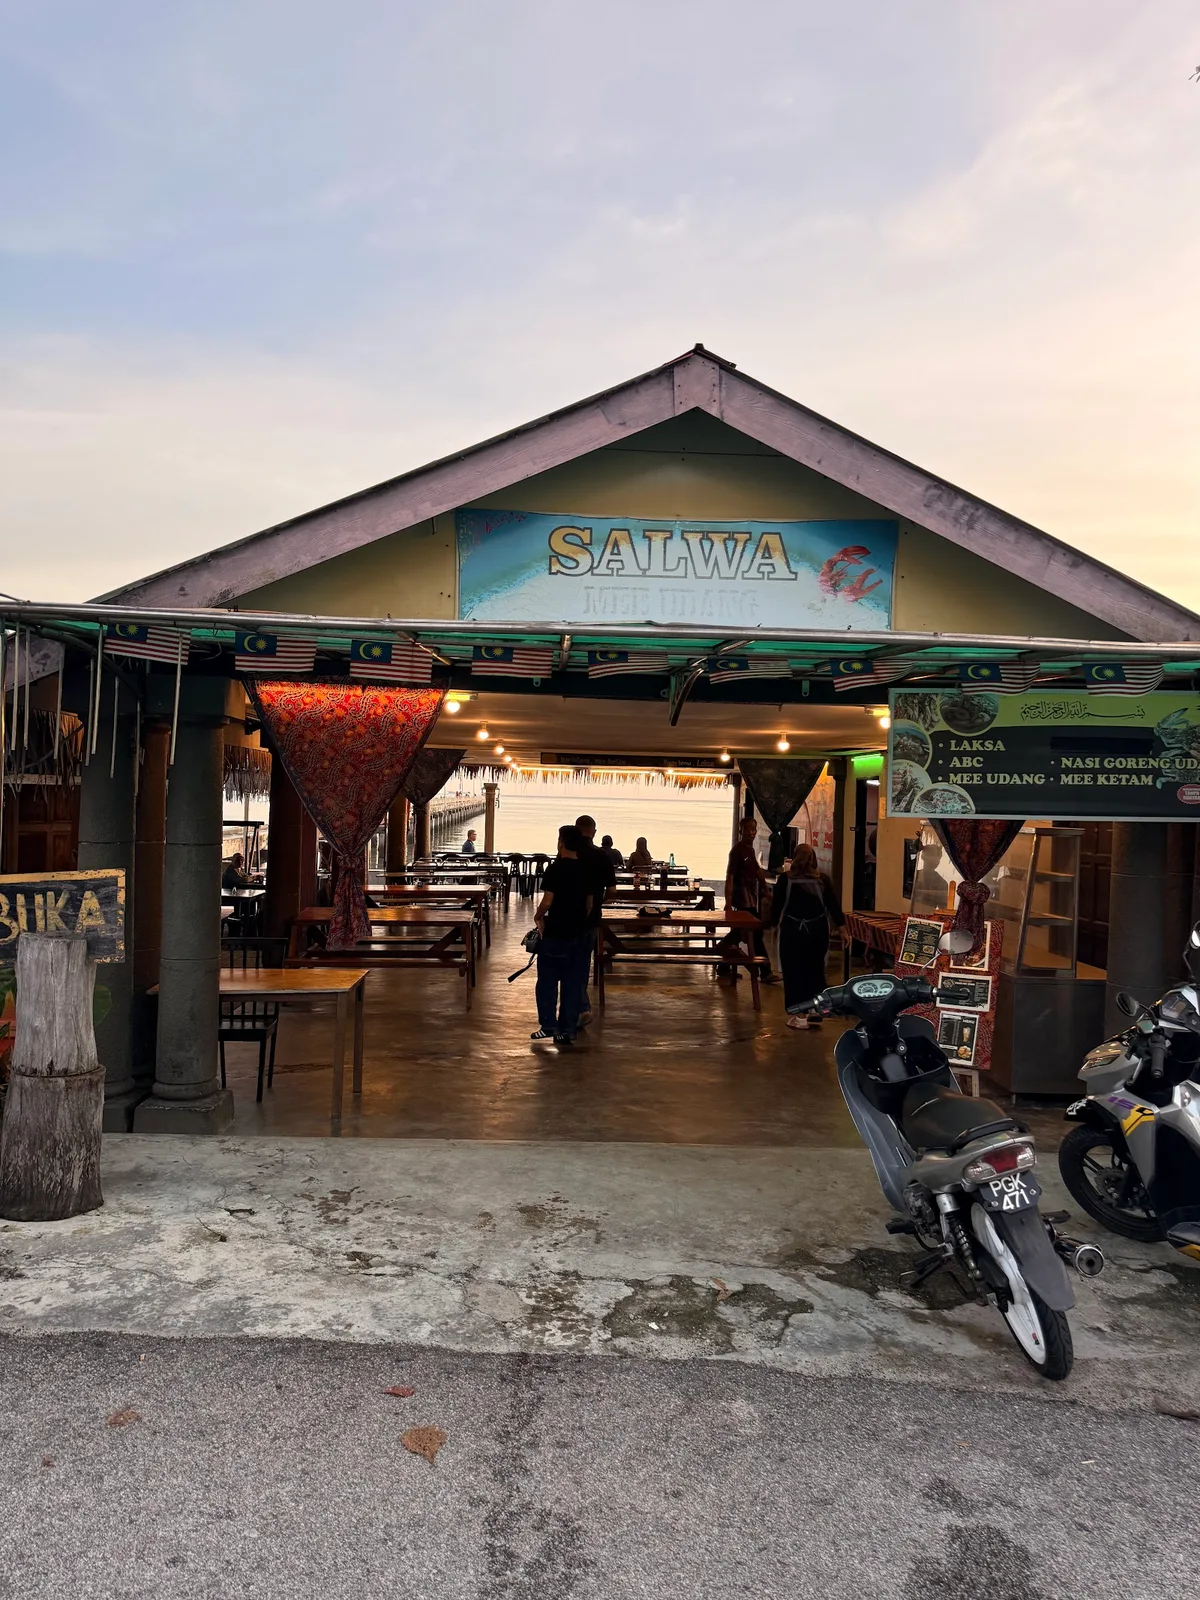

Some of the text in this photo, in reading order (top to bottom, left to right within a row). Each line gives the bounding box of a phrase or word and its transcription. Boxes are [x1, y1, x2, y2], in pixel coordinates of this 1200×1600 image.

[548, 526, 798, 582] SALWA
[949, 740, 1005, 751] LAKSA
[949, 756, 983, 768] ABC
[1060, 757, 1200, 770] NASI GORENG UD
[948, 773, 1045, 785] MEE UDANG
[1060, 773, 1153, 785] MEE KETAM
[989, 1173, 1027, 1196] PGK
[1003, 1190, 1030, 1210] 471
